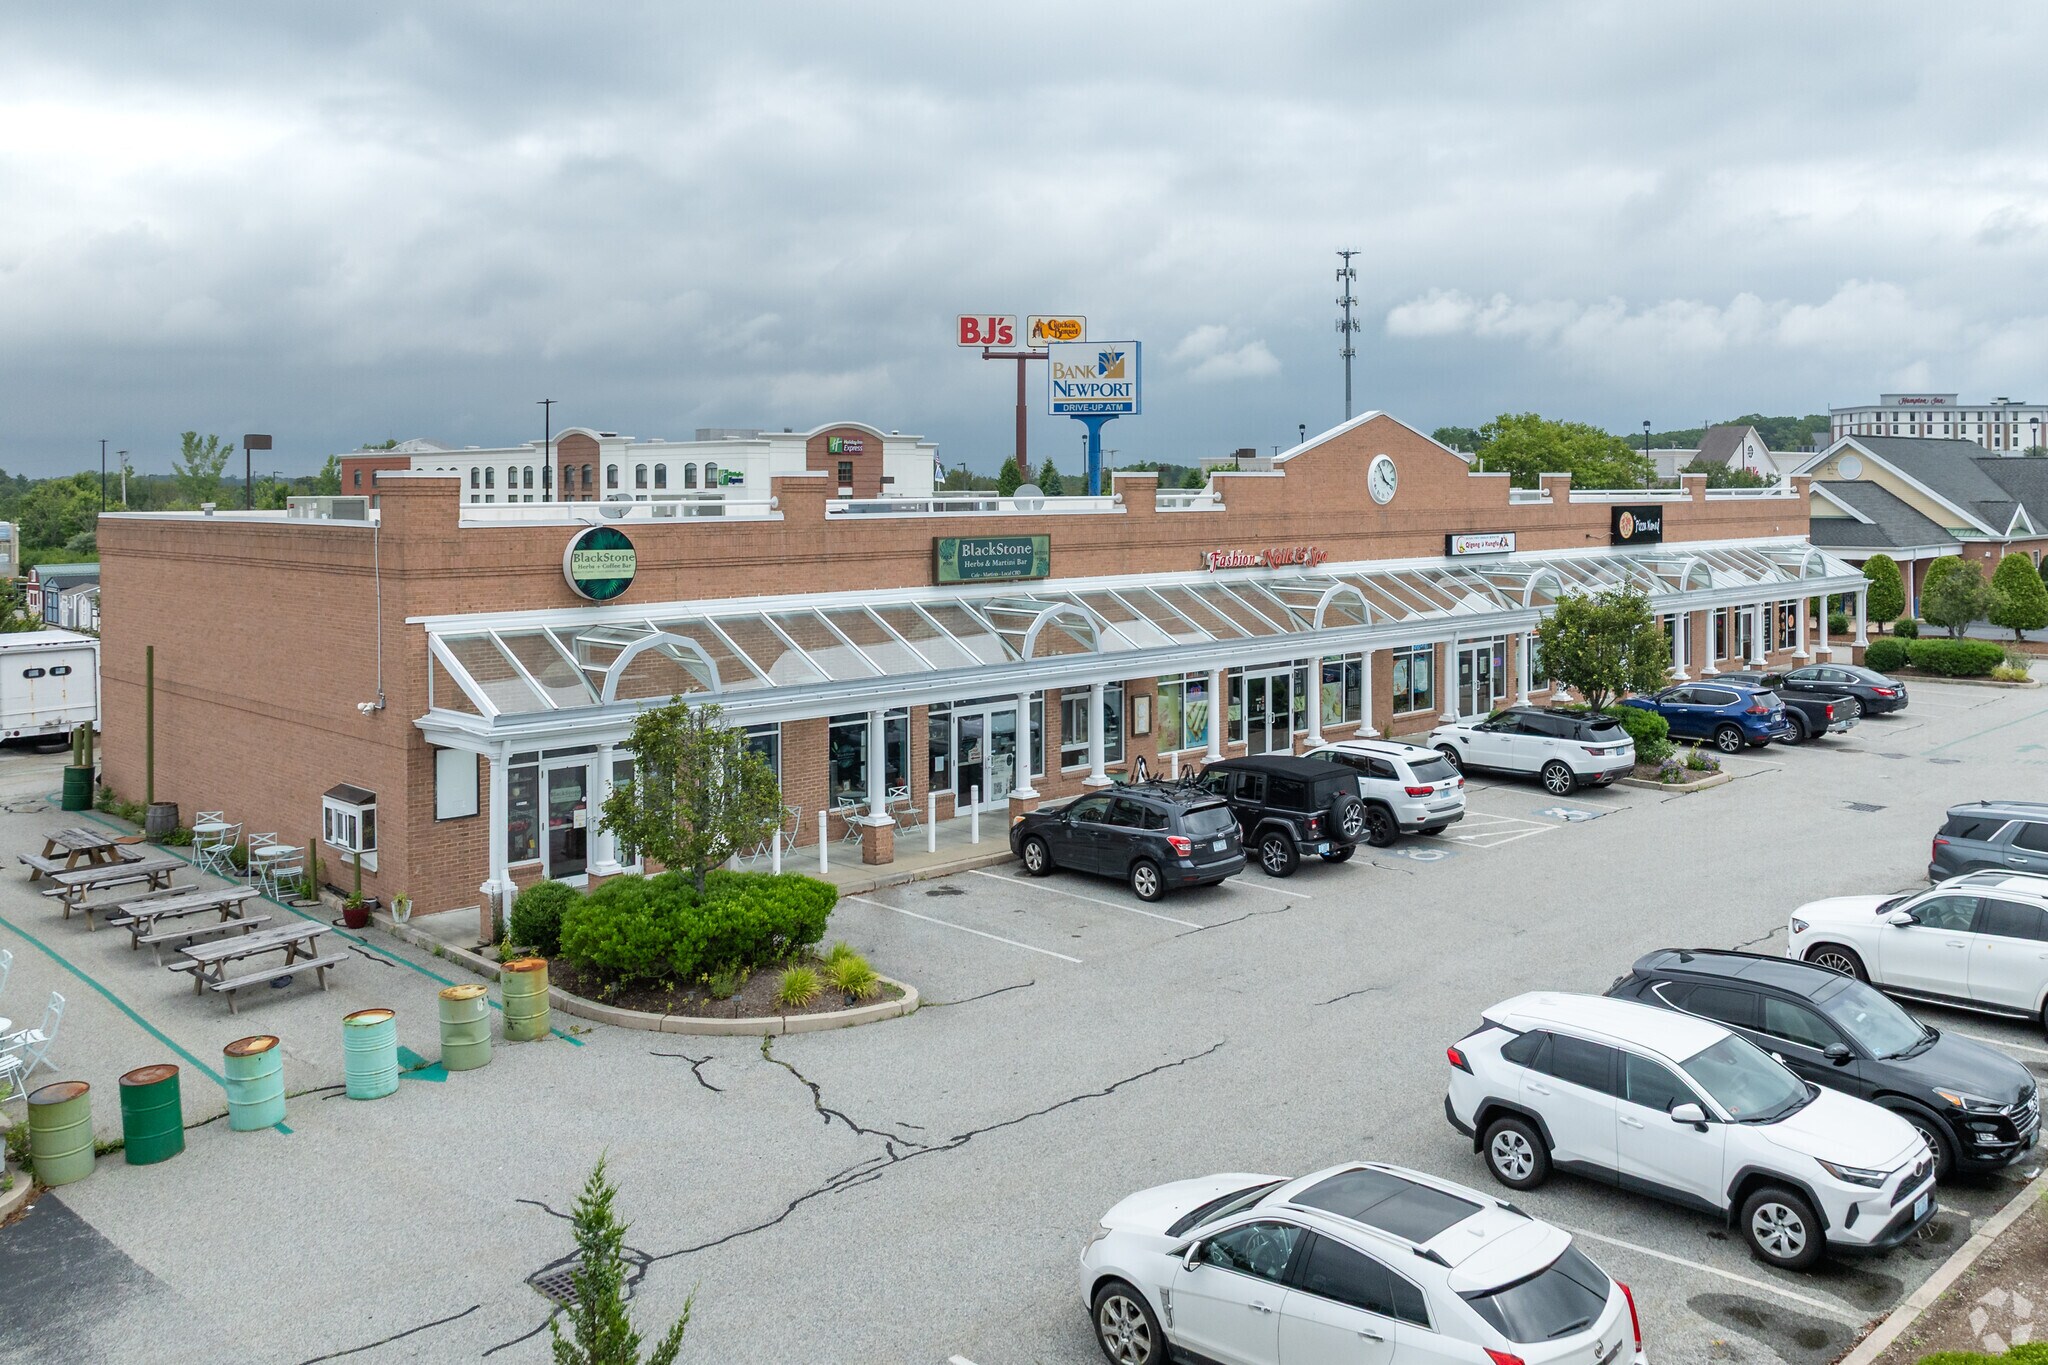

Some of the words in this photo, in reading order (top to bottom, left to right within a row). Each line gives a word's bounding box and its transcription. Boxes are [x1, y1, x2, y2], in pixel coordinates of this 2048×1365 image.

[960, 317, 1013, 344] BJ's
[1048, 319, 1076, 331] Cracker
[1054, 327, 1078, 338] Barrel
[1053, 362, 1097, 379] BANK
[1053, 380, 1132, 397] NEWPORT
[1063, 403, 1104, 412] DRIVE-UP
[1105, 402, 1123, 411] ATM
[962, 542, 1032, 557] BlackStone
[573, 552, 635, 563] BlackStone
[964, 560, 984, 568] Herbs
[992, 559, 1016, 567] Martini
[1209, 550, 1256, 573] Fashion
[1260, 547, 1294, 570] Nails
[1294, 546, 1307, 564] &
[1306, 546, 1328, 567] Spa
